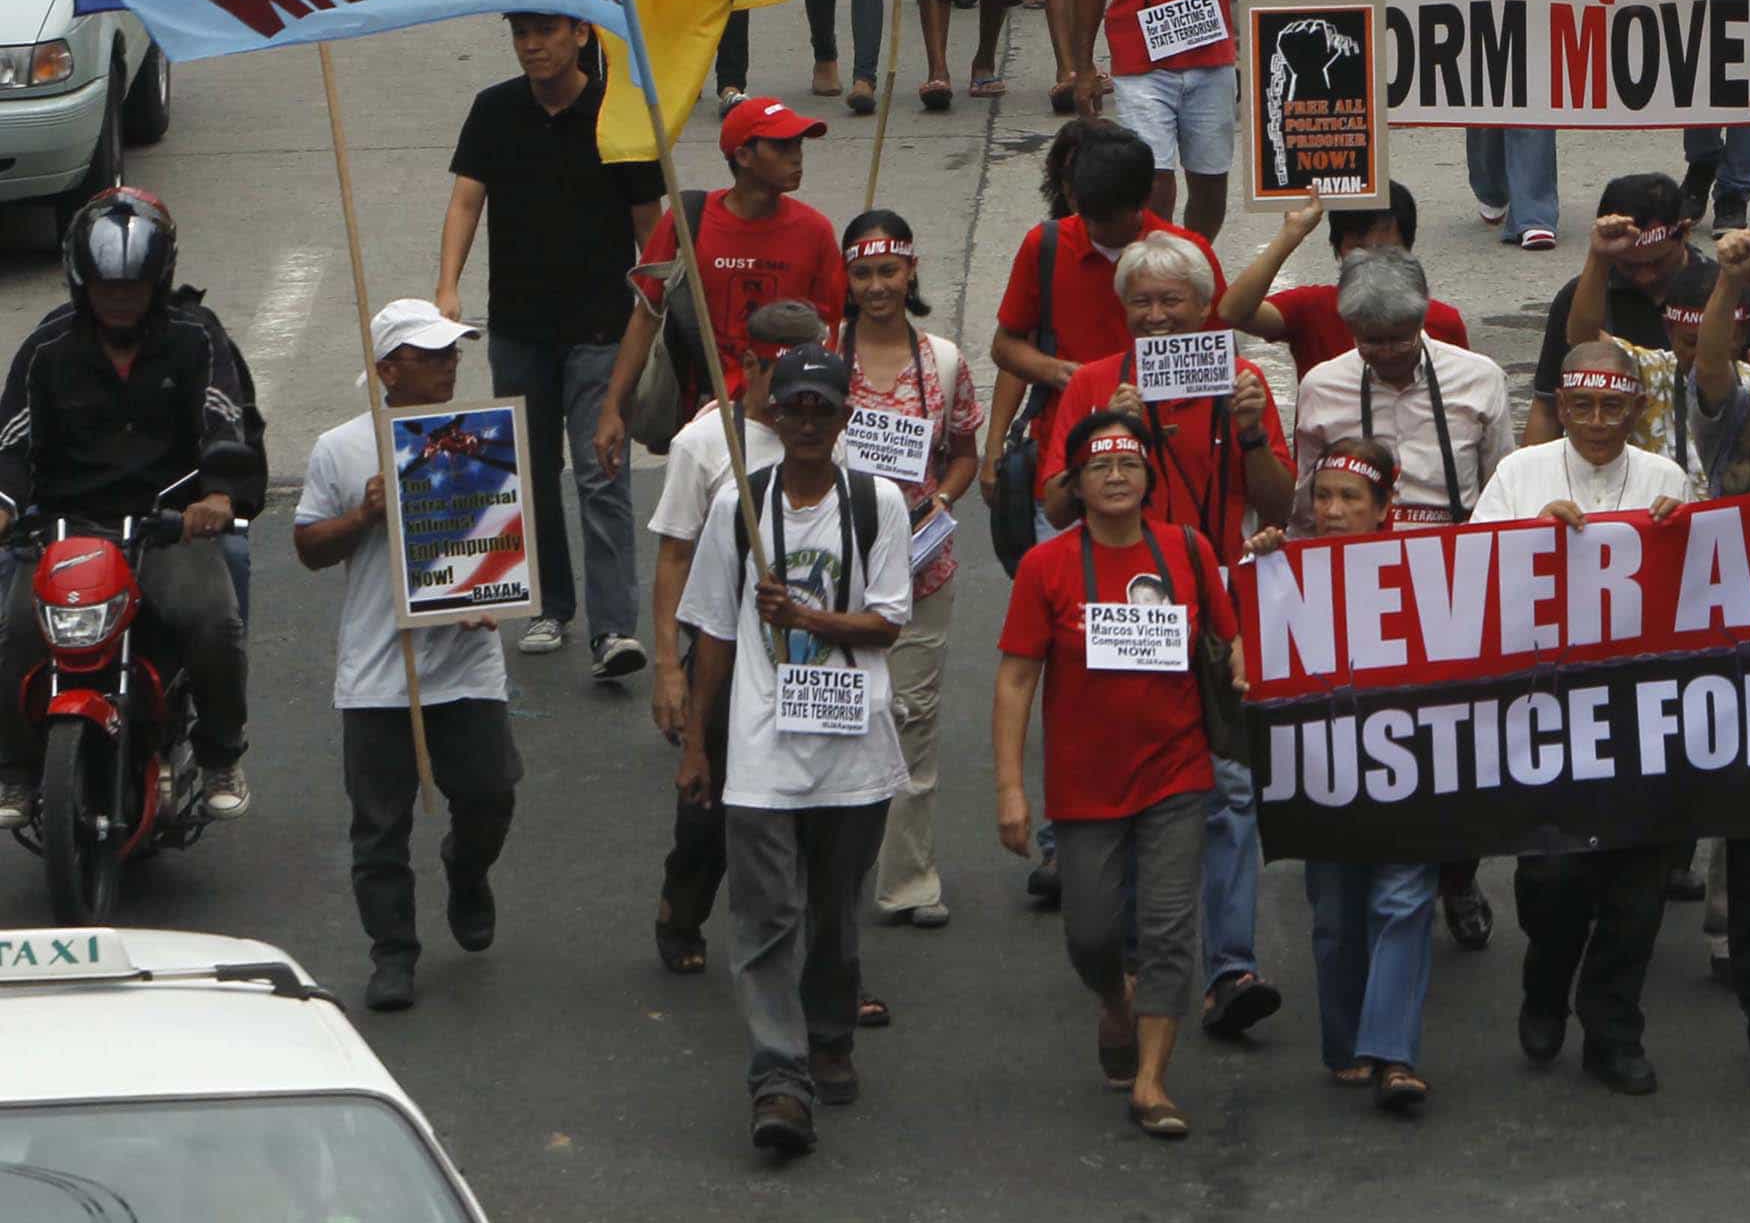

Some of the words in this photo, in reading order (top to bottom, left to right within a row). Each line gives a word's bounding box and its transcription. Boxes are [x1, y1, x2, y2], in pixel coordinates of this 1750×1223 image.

[1170, 9, 1206, 28] VICTIMS
[1150, 31, 1174, 49] STATE
[1284, 100, 1328, 115] FREE
[1333, 98, 1366, 114] ALL
[1284, 117, 1367, 132] POLITICAL
[1286, 133, 1367, 148] PRISONER
[1296, 149, 1357, 171] NOW!
[715, 258, 755, 269] OUST
[1143, 335, 1226, 356] JUSTICE
[1142, 357, 1155, 370] for
[1158, 356, 1170, 369] all
[1172, 352, 1215, 369] VICTIMS
[1217, 351, 1227, 365] of
[1142, 371, 1171, 387] STATE
[1173, 366, 1229, 385] TERRORISM!
[1584, 374, 1607, 389] ANG
[852, 410, 889, 429] ASS
[896, 419, 924, 436] the
[883, 431, 923, 449] Victims
[1091, 439, 1113, 453] END
[860, 450, 897, 464] NOW!
[411, 565, 454, 587] Now!
[1255, 522, 1643, 681] NEVER
[1091, 607, 1140, 623] PASS
[1147, 609, 1178, 624] the
[1091, 624, 1132, 636] Marcos
[1136, 625, 1180, 637] Victims
[1118, 648, 1156, 657] NOW!
[783, 669, 864, 689] JUSTICE
[782, 685, 796, 699] for
[797, 687, 809, 701] all
[812, 687, 851, 704] VICTIMS
[854, 690, 864, 704] of
[782, 702, 808, 718] STATE
[1263, 684, 1615, 807] JUSTICE
